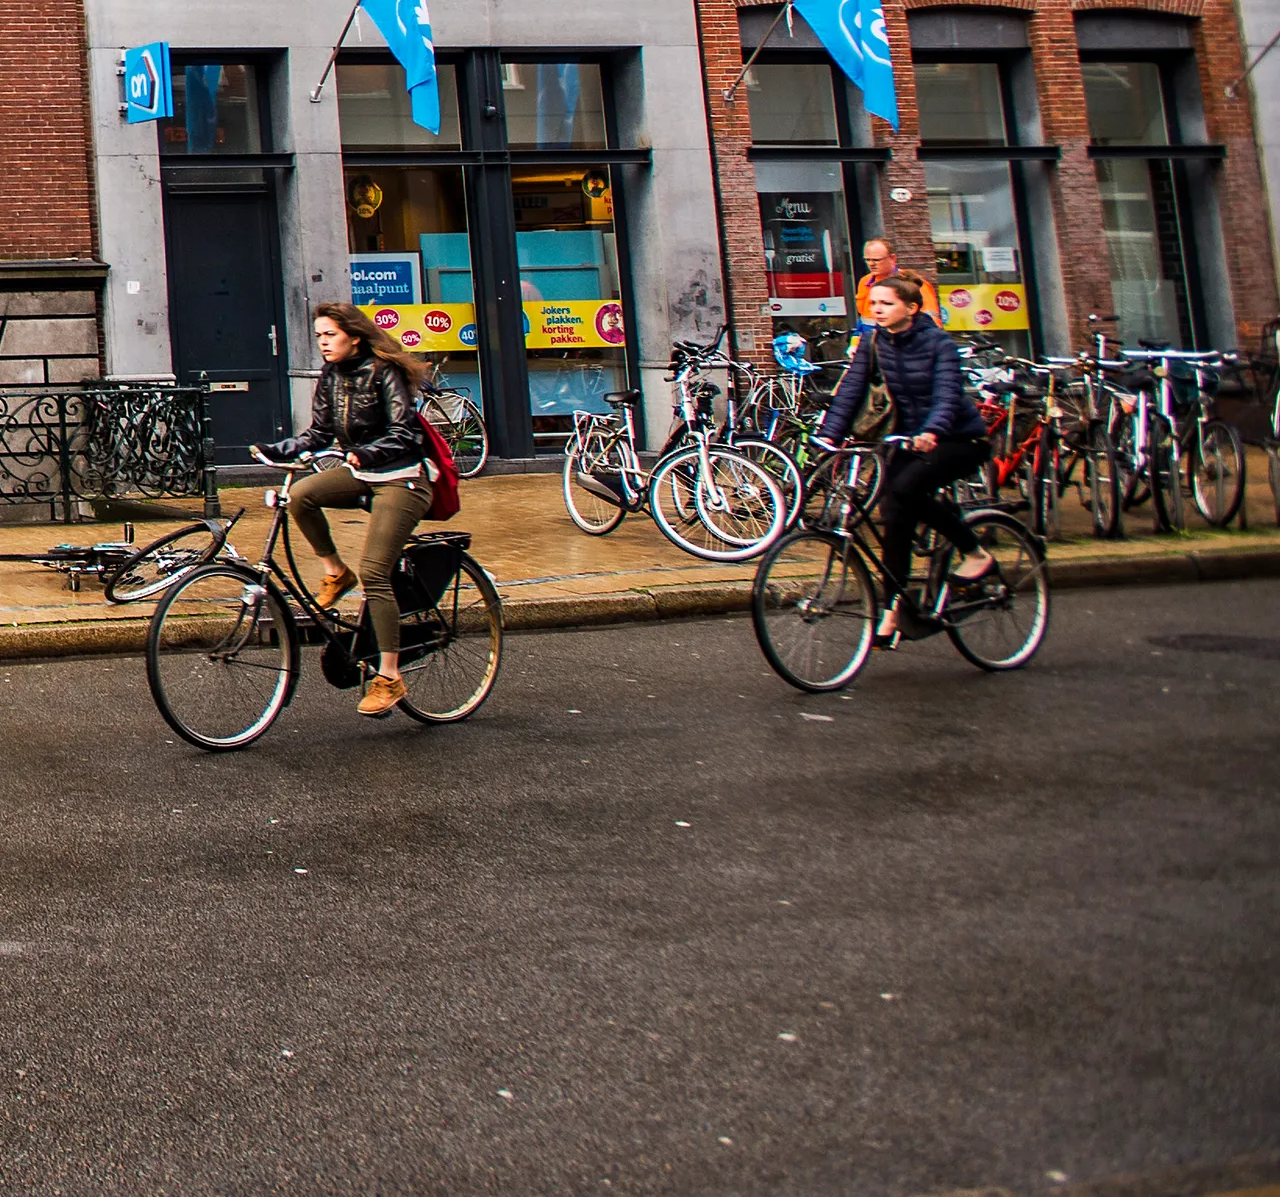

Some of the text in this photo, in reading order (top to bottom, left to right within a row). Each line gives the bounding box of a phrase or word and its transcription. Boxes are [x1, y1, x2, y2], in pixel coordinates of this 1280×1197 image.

[775, 197, 812, 219] Menu
[785, 253, 816, 265] gratis!
[350, 269, 397, 281] ol.com
[997, 295, 1019, 308] 10%
[540, 306, 571, 314] Jokers
[375, 313, 398, 326] 30%
[426, 316, 450, 329] 10%
[461, 329, 477, 341] 40
[542, 324, 575, 335] korting
[402, 334, 421, 344] 50%
[550, 334, 586, 345] pakken.
